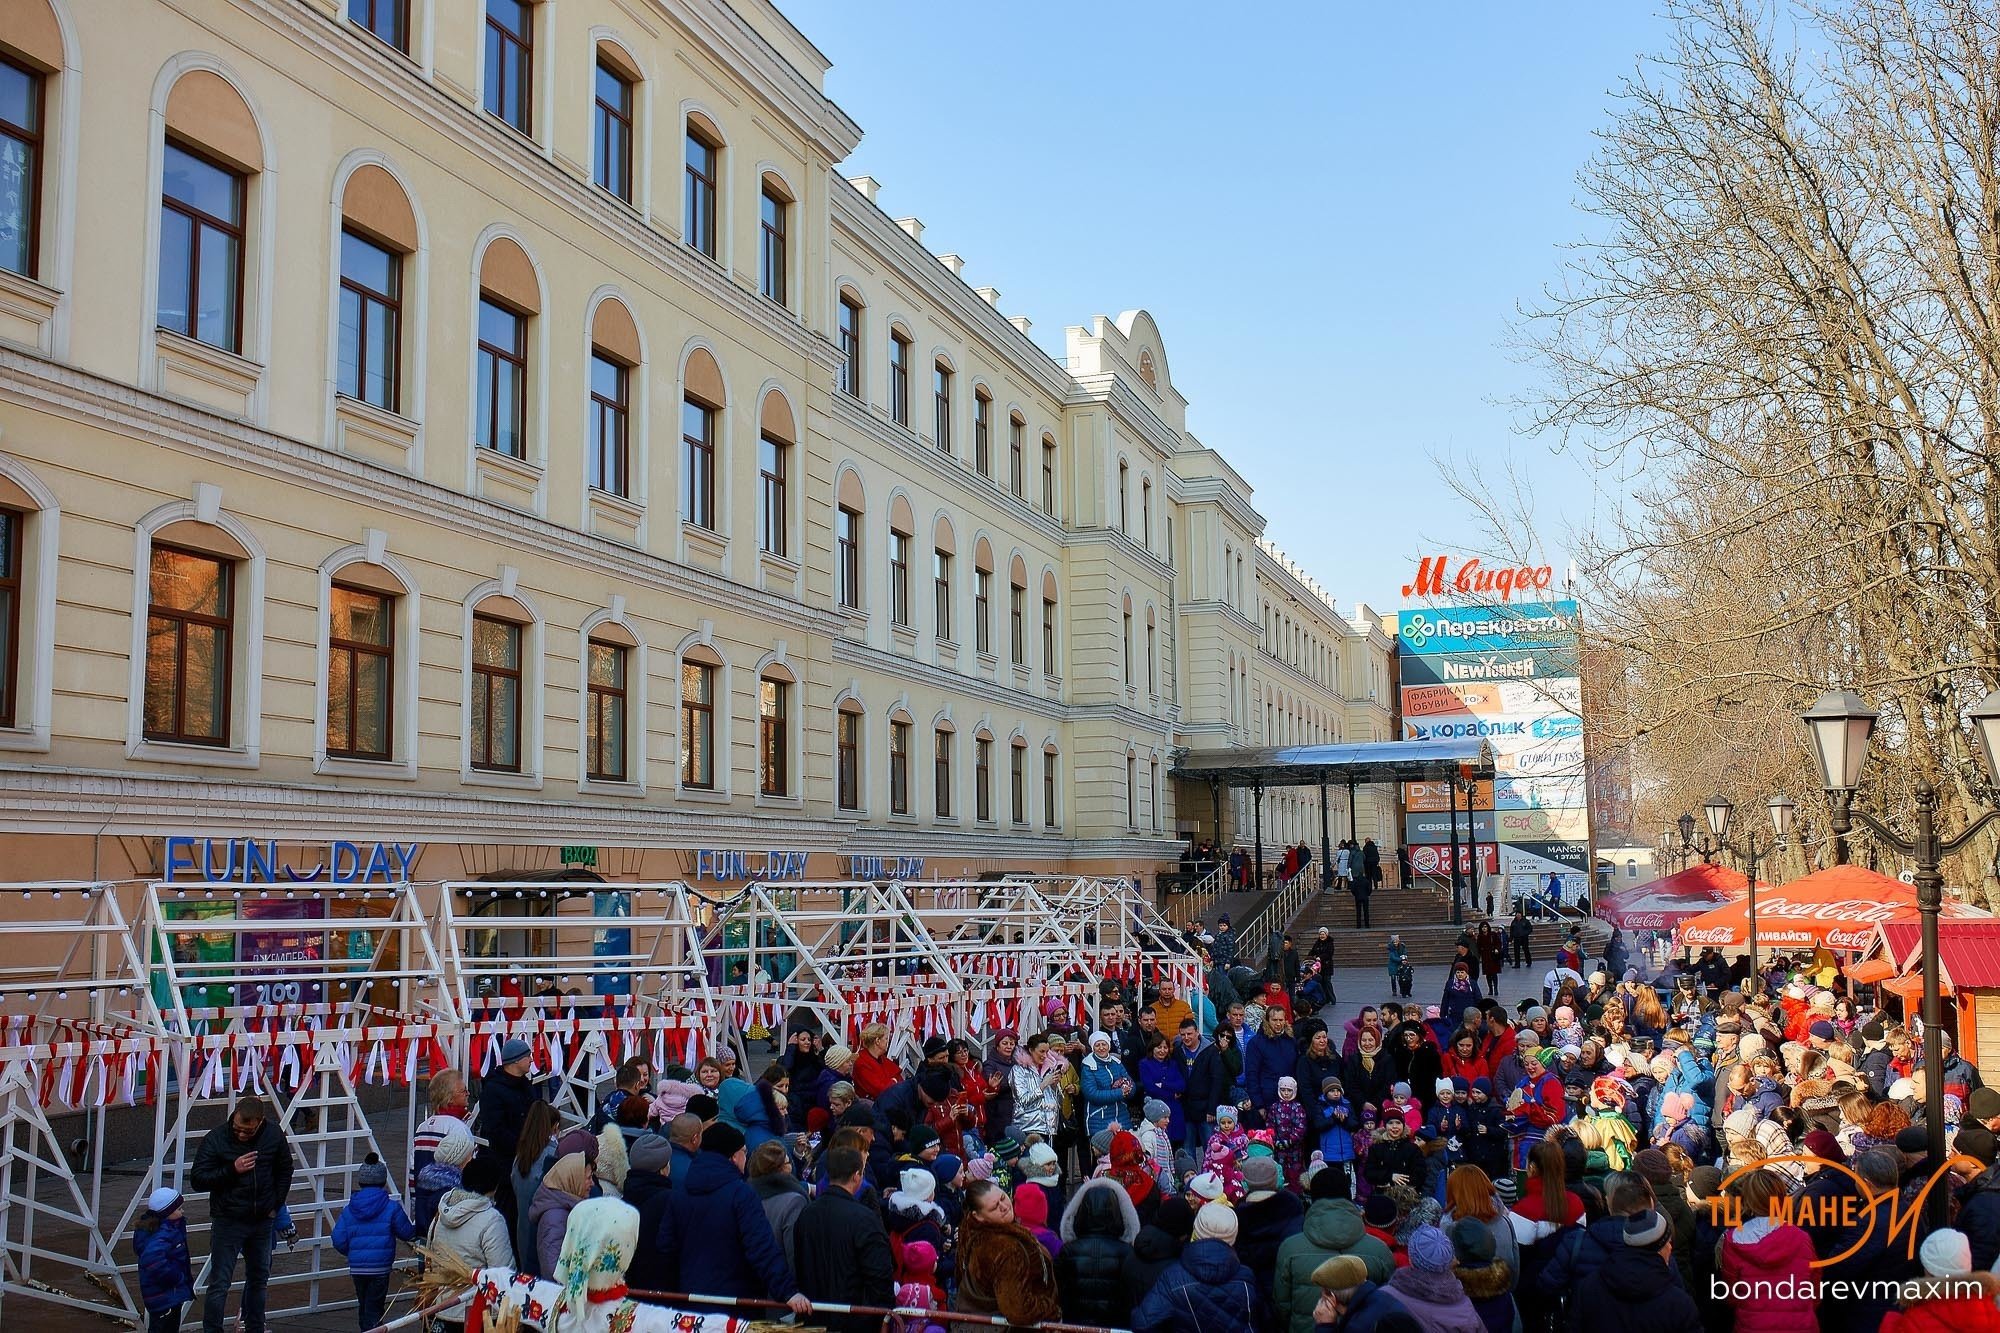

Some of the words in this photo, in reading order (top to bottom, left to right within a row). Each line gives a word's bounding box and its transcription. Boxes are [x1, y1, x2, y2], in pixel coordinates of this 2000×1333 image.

[1411, 686, 1462, 701] ФАБРИКА
[1413, 698, 1449, 712] ОБУВИ
[1431, 719, 1526, 739] кораблик
[1461, 798, 1489, 807] ЭАЖ
[564, 846, 597, 866] ВХОД
[1547, 845, 1585, 854] MANGO
[164, 837, 276, 884] FUN
[330, 841, 418, 884] DAY
[697, 849, 745, 881] FUN
[767, 851, 809, 881] DAY
[851, 855, 884, 880] FUN
[896, 856, 924, 879] DAY
[1623, 913, 1665, 928] Coca-Cola
[1684, 925, 1736, 944] Coca-Cola
[1756, 930, 1813, 942] ЛИВАЙСЯ!
[1825, 928, 1873, 948] Coca-Co
